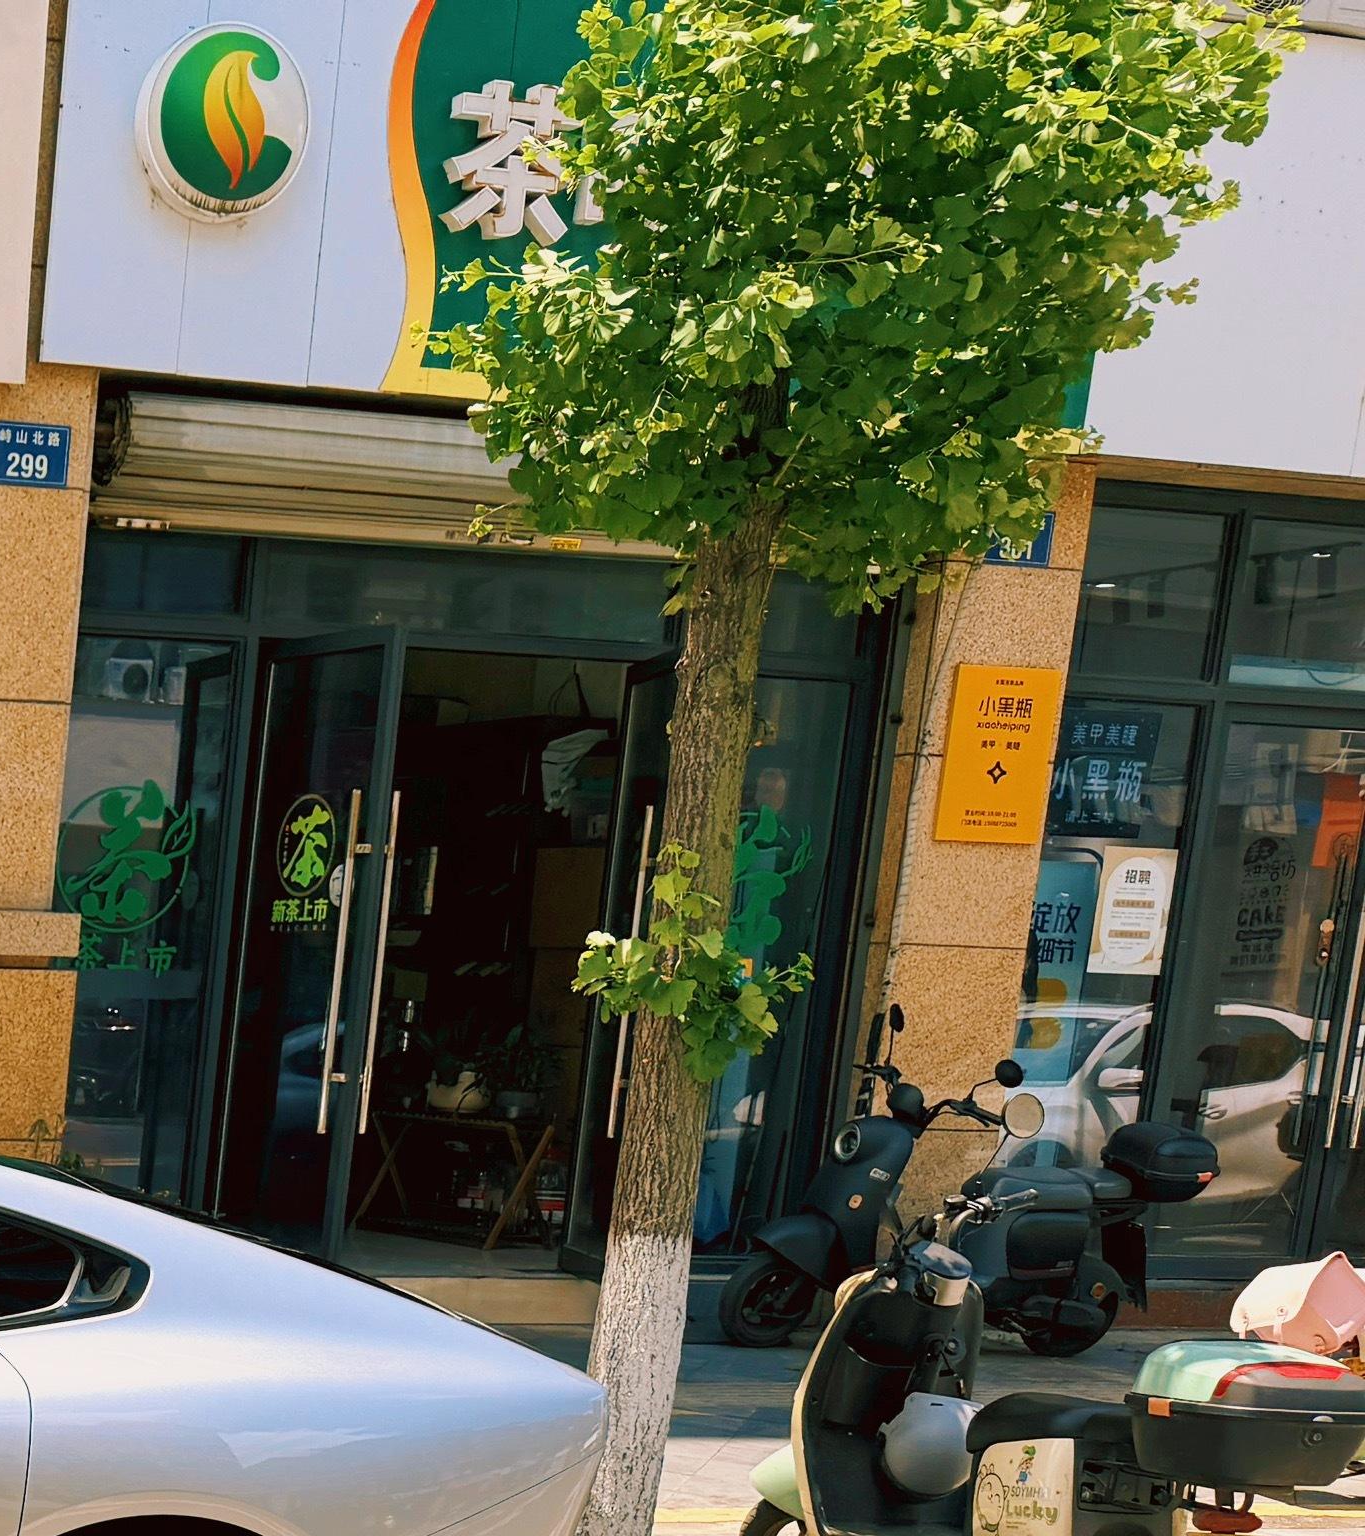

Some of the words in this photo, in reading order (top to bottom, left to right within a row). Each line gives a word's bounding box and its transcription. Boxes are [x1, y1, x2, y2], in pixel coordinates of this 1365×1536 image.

[439, 80, 614, 247] 茶
[6, 452, 48, 479] 299
[978, 696, 1033, 718] 小黑瓶
[977, 721, 1030, 733] xiaoheiping
[1071, 722, 1138, 746] 美甲美睫
[1051, 758, 1147, 803] 小黑瓶
[1125, 869, 1151, 885] 招聘
[272, 898, 329, 922] 新茶上市
[73, 932, 177, 979] 茶上市
[1006, 1500, 1060, 1526] Lucky
